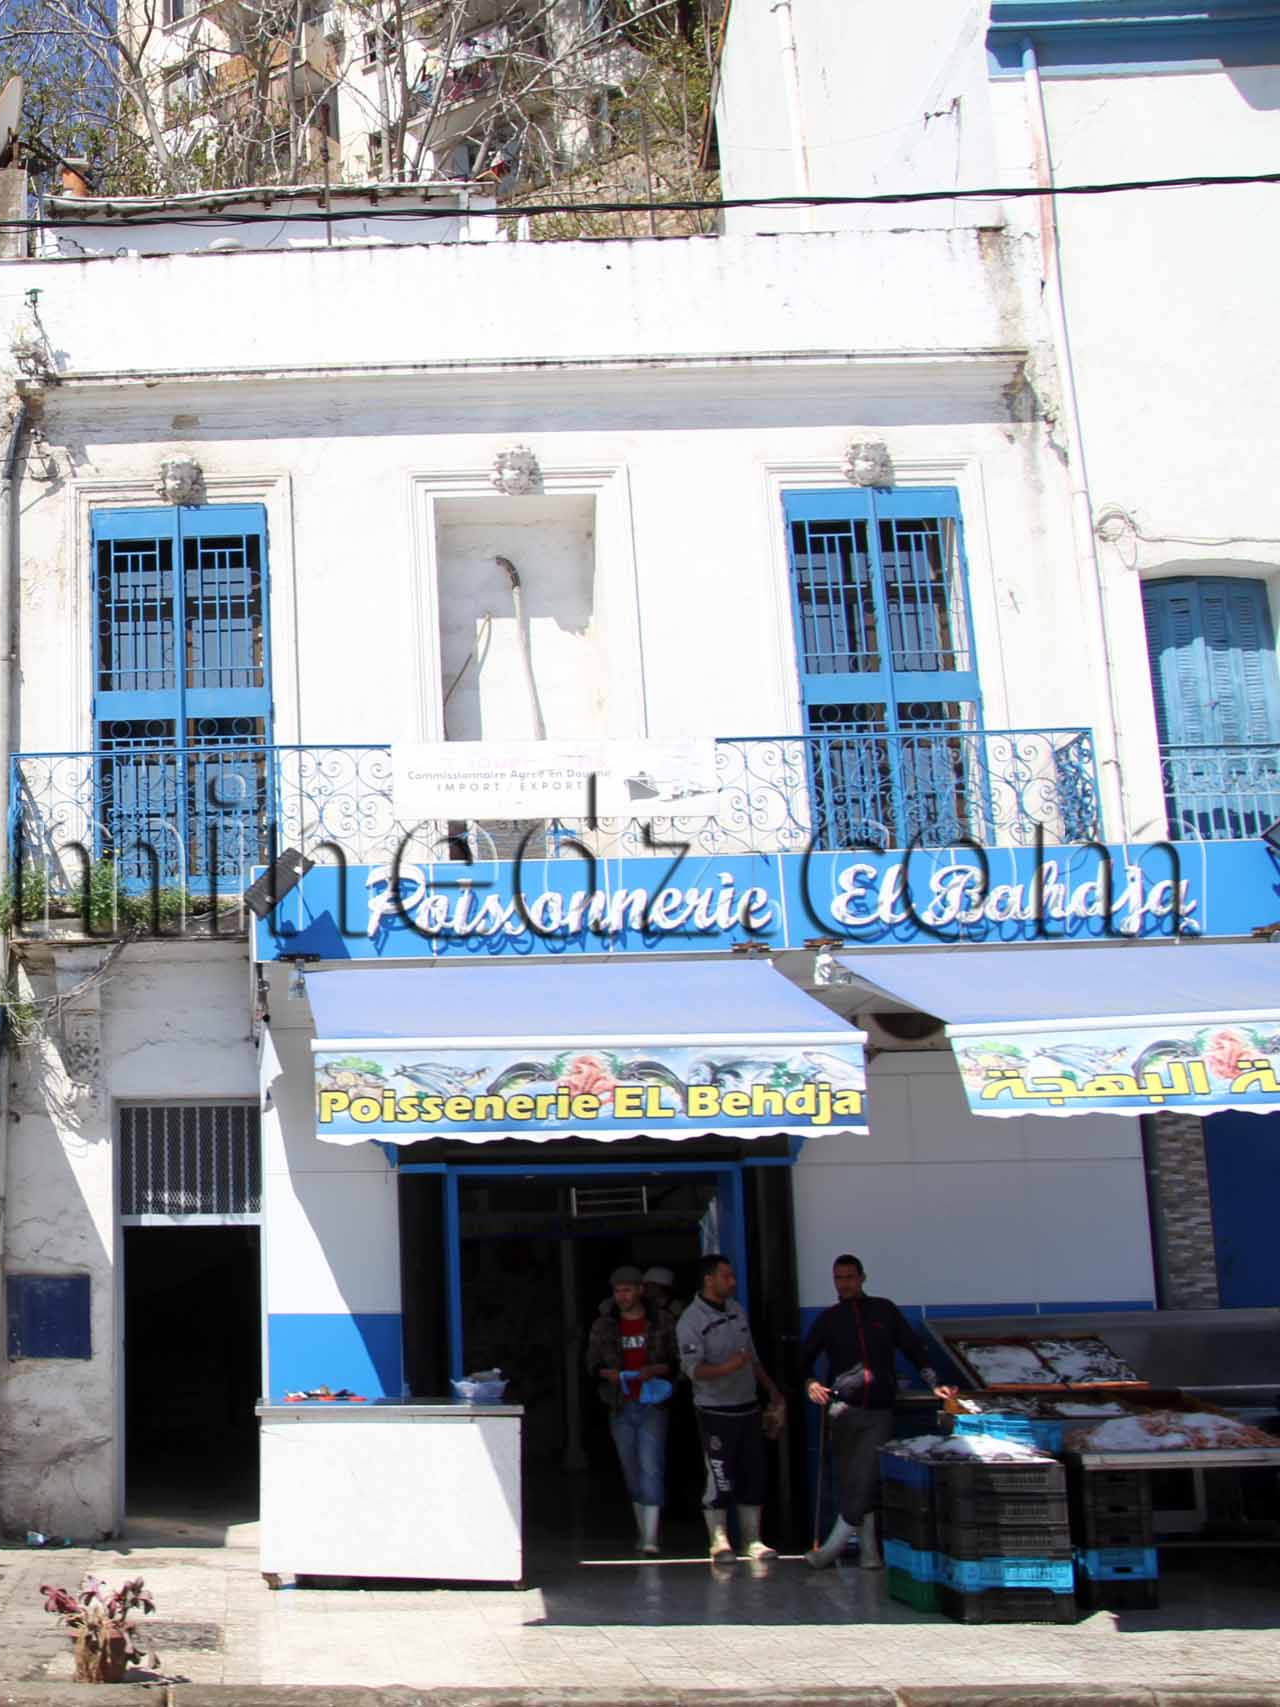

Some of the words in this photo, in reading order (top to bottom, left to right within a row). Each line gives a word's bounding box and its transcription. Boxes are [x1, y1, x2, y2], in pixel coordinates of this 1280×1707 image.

[436, 783, 500, 792] IMPORT
[519, 781, 583, 791] EXPORT
[365, 863, 773, 938] Poissonnerie
[830, 863, 910, 926] El
[921, 858, 1198, 936] Bahdja
[319, 1086, 601, 1123] Poissenerie
[613, 1086, 681, 1119] EL
[687, 1081, 863, 1125] Behdja
[980, 1059, 1211, 1106] البهجة
